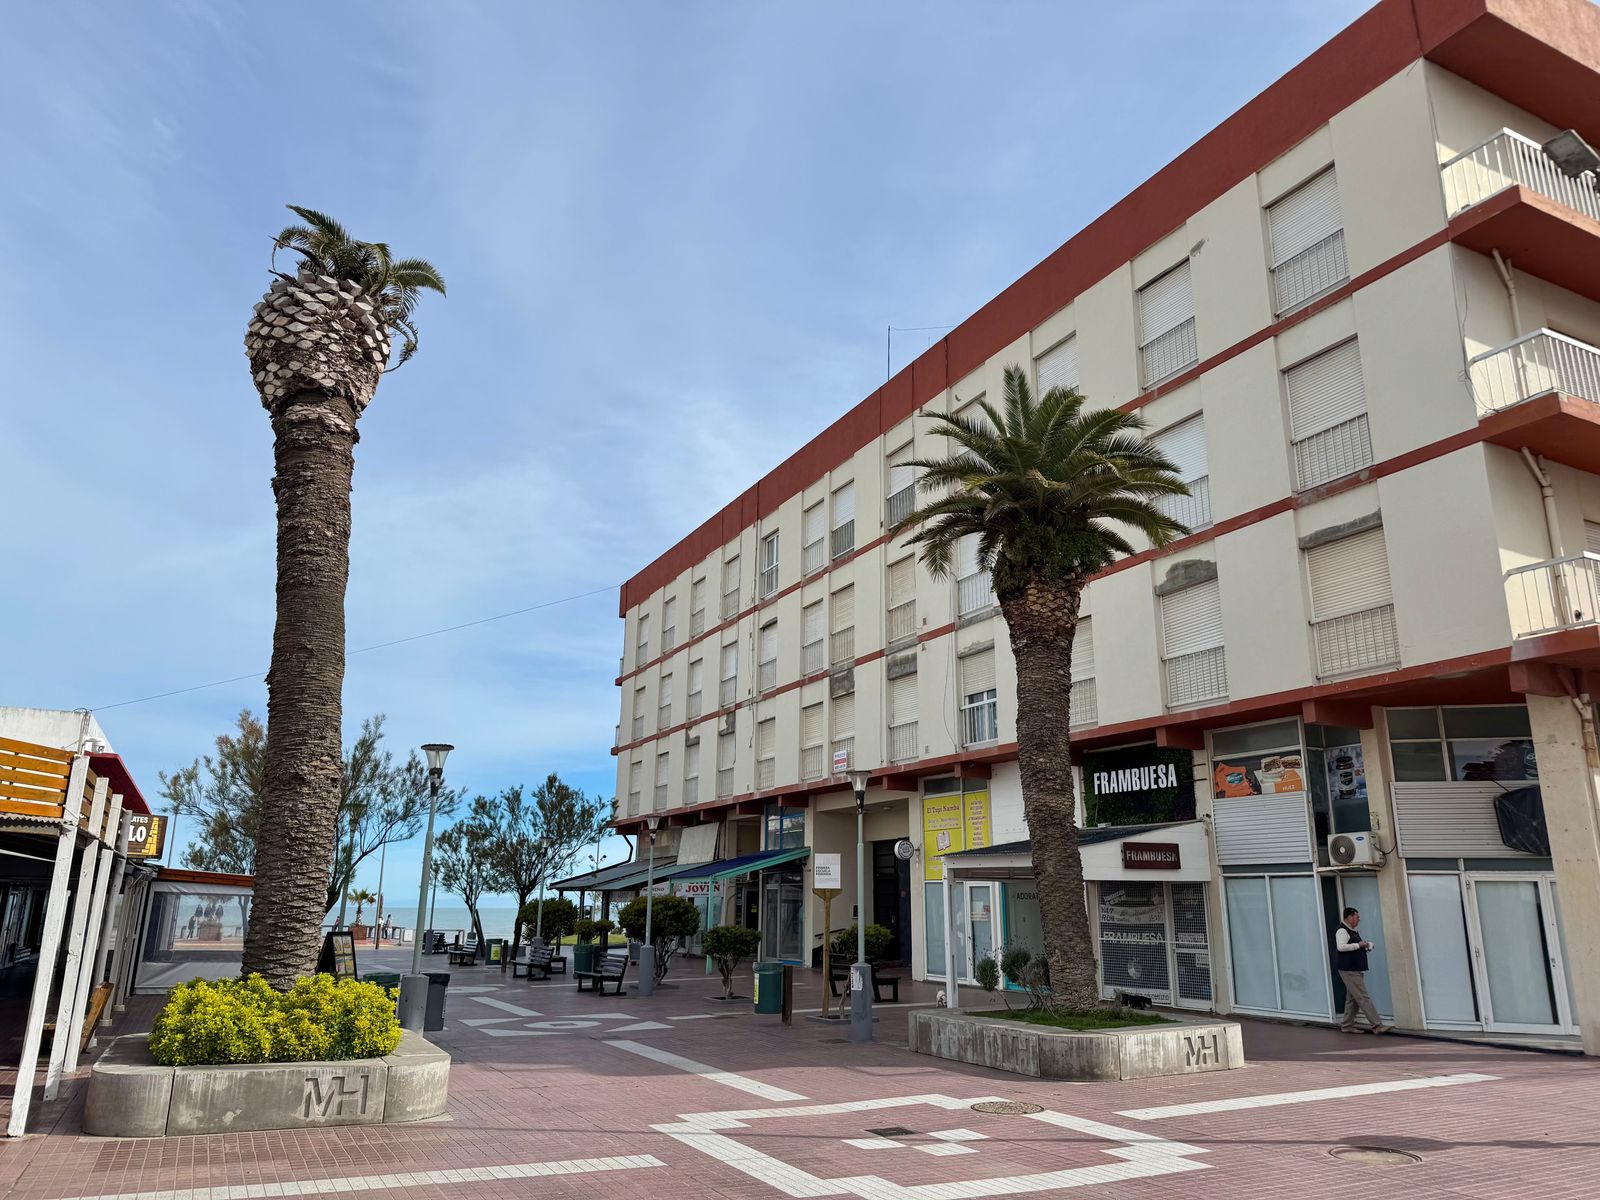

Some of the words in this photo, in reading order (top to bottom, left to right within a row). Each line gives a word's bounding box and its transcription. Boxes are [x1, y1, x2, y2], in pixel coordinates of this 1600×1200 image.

[1093, 763, 1178, 795] FRAMBUESA
[1126, 850, 1178, 862] FRAMBUESA
[1102, 931, 1164, 945] FRAMBUESA
[1184, 1034, 1219, 1067] MH
[303, 1074, 369, 1118] MH
